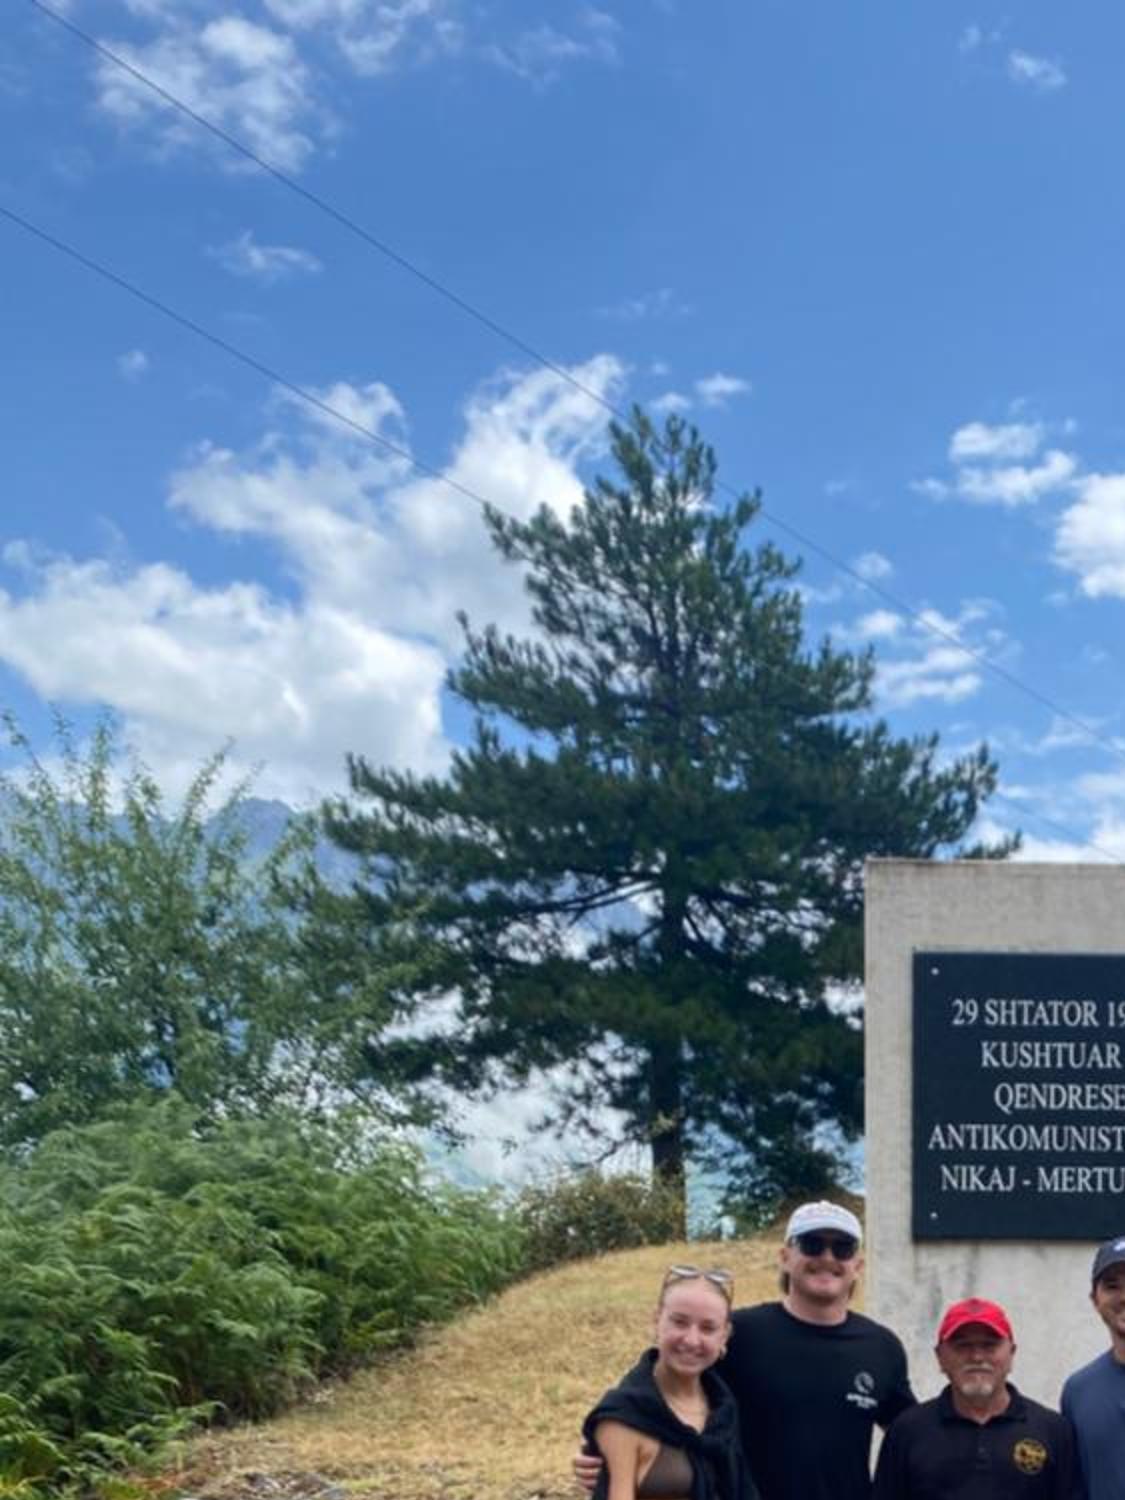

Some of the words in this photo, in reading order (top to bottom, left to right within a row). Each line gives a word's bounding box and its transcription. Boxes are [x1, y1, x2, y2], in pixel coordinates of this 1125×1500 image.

[952, 998, 981, 1026] 29
[984, 998, 1099, 1027] SHTATOR
[981, 1040, 1123, 1069] KUSHTUAR
[940, 1164, 1016, 1193] NIKAJ
